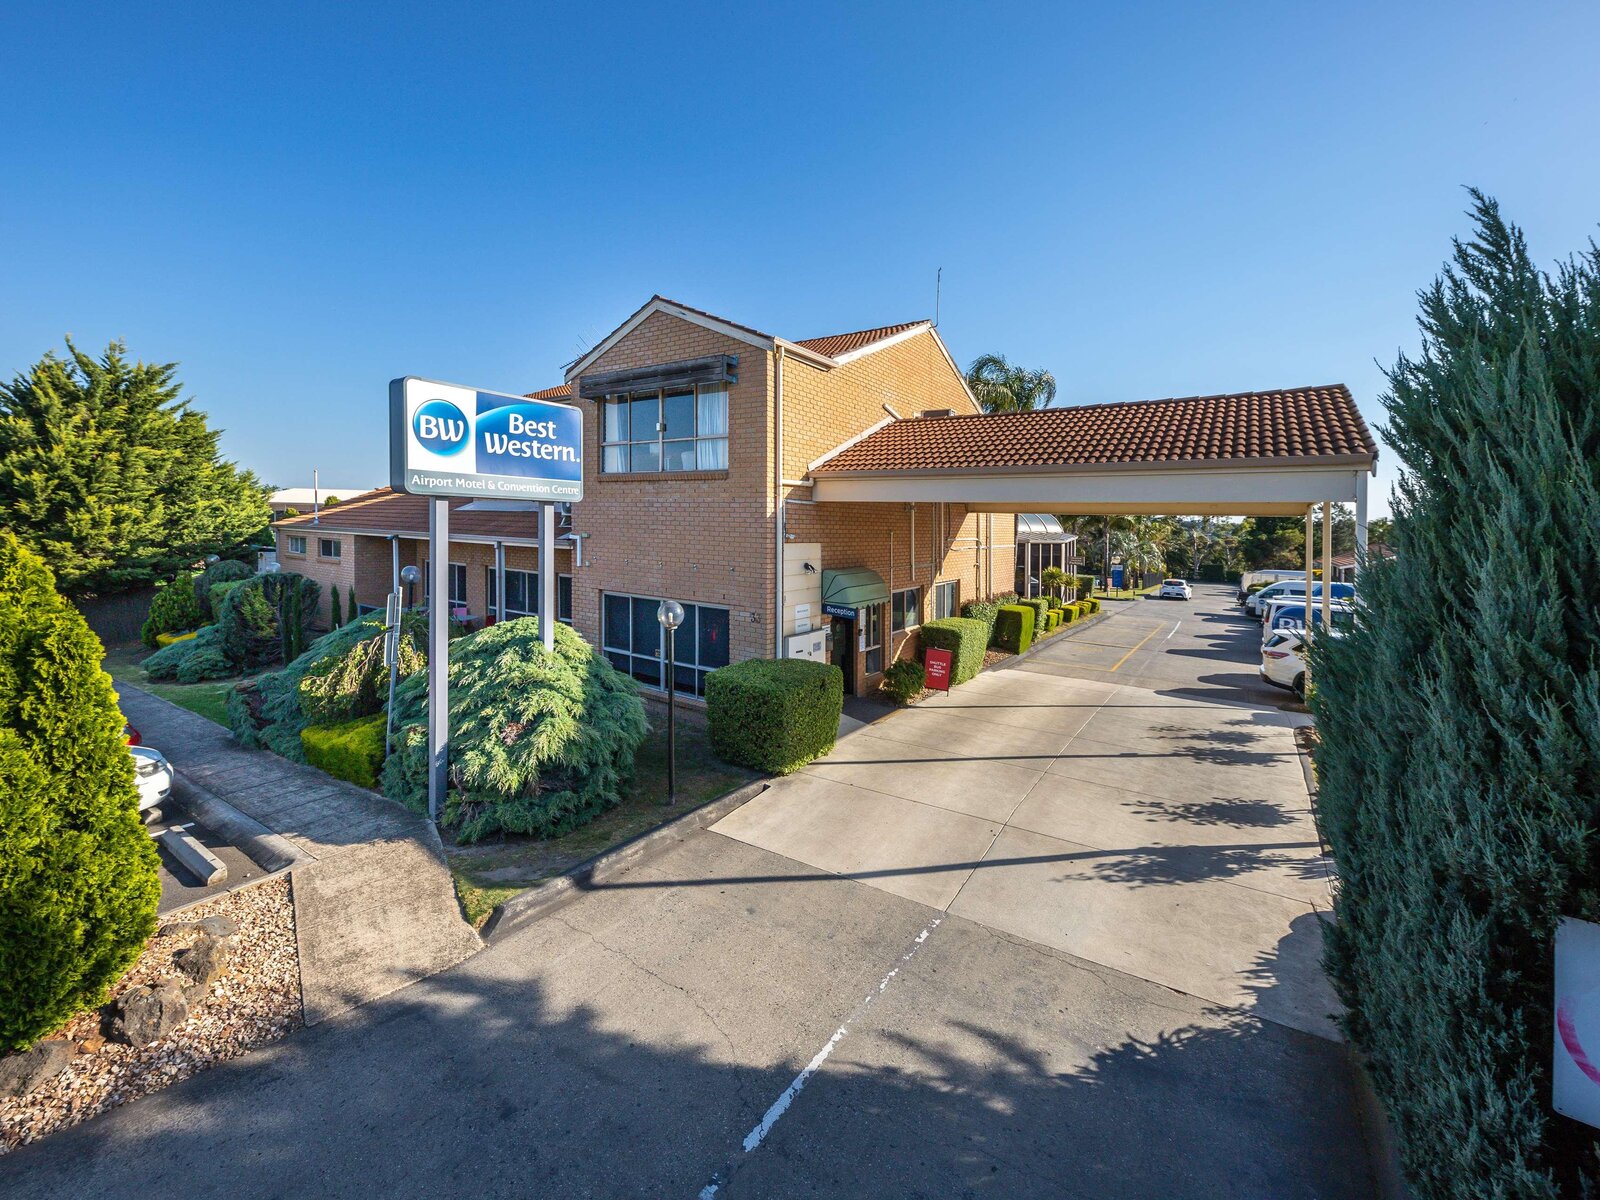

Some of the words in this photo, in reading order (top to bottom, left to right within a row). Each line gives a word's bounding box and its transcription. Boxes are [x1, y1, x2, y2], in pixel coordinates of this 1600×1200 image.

[419, 415, 465, 442] BW
[509, 413, 557, 440] Best
[411, 474, 453, 488] Airport
[455, 478, 486, 490] Motel
[487, 480, 496, 490] &
[497, 481, 550, 494] Convention
[551, 485, 579, 495] Centre
[826, 606, 856, 617] Reception
